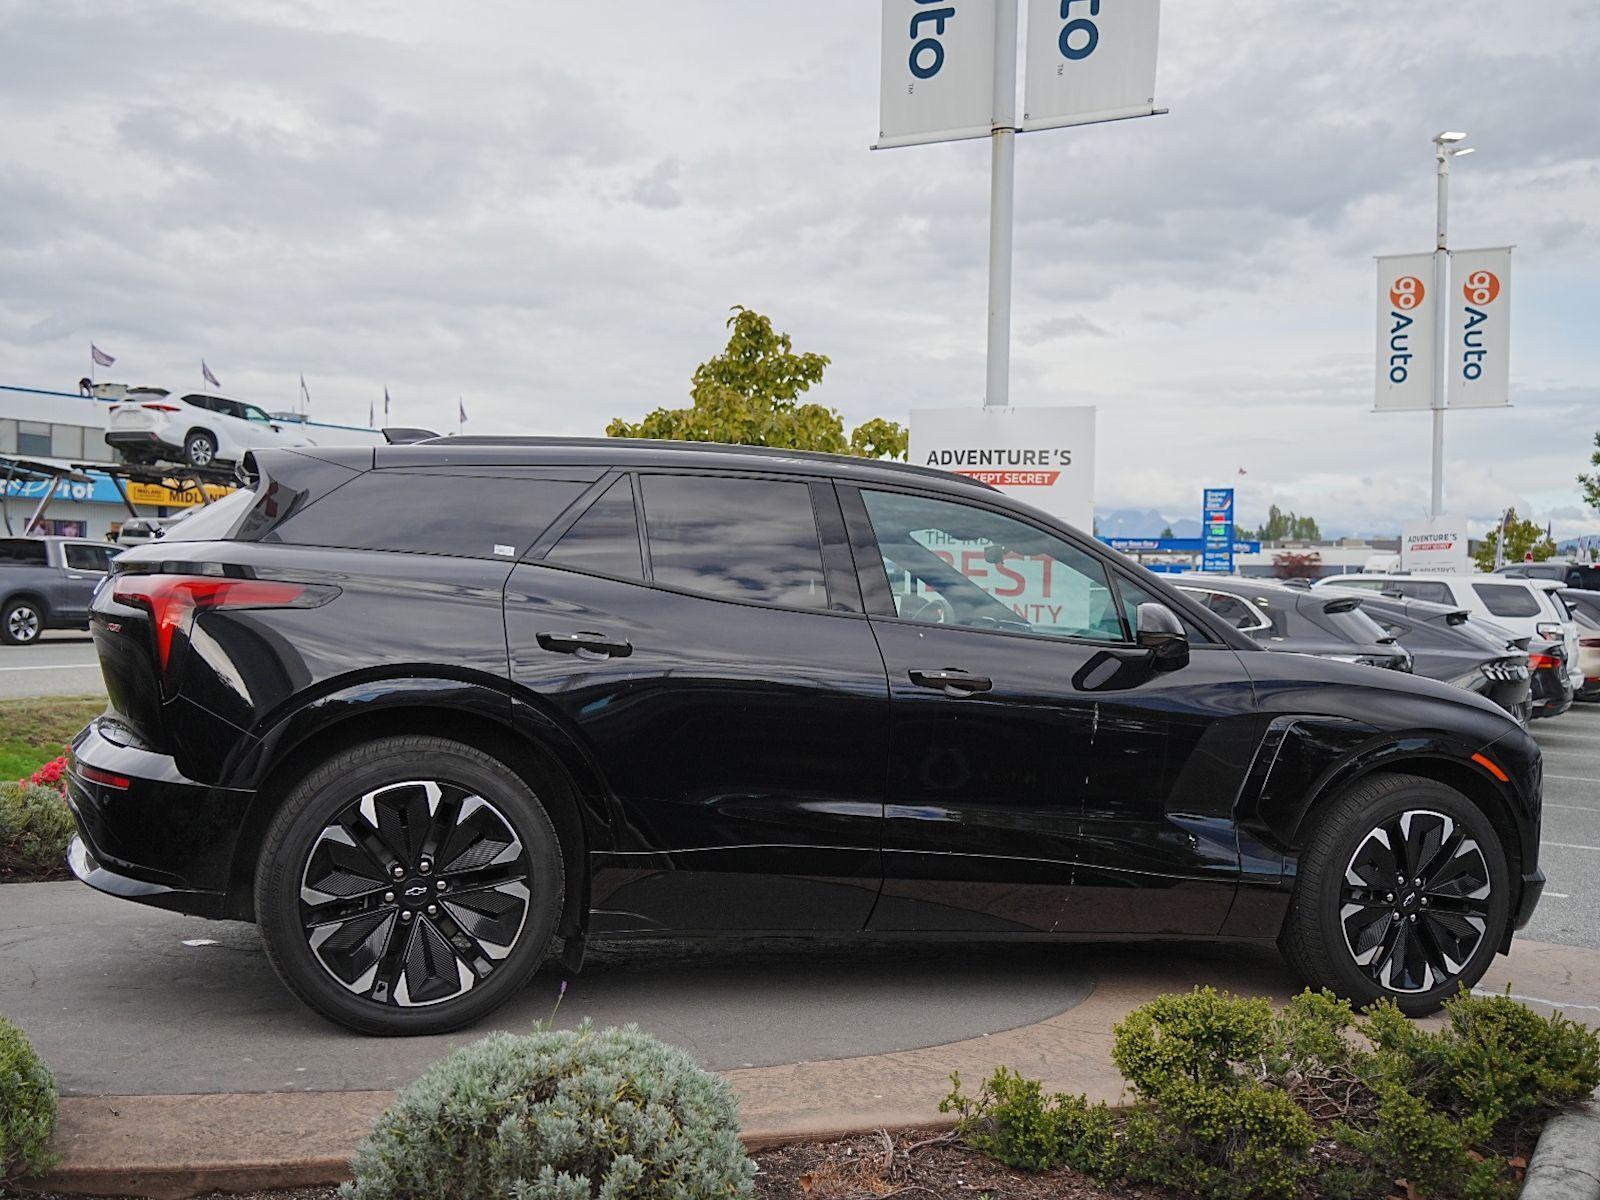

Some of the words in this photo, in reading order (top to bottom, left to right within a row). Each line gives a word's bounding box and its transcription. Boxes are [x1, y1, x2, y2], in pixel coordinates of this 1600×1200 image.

[1391, 276, 1417, 310] go
[1465, 271, 1490, 305] go
[1389, 311, 1414, 384] Auto
[1463, 306, 1488, 380] Auto
[927, 449, 1072, 466] ADVENTURE'S
[1004, 473, 1051, 484] SECRET
